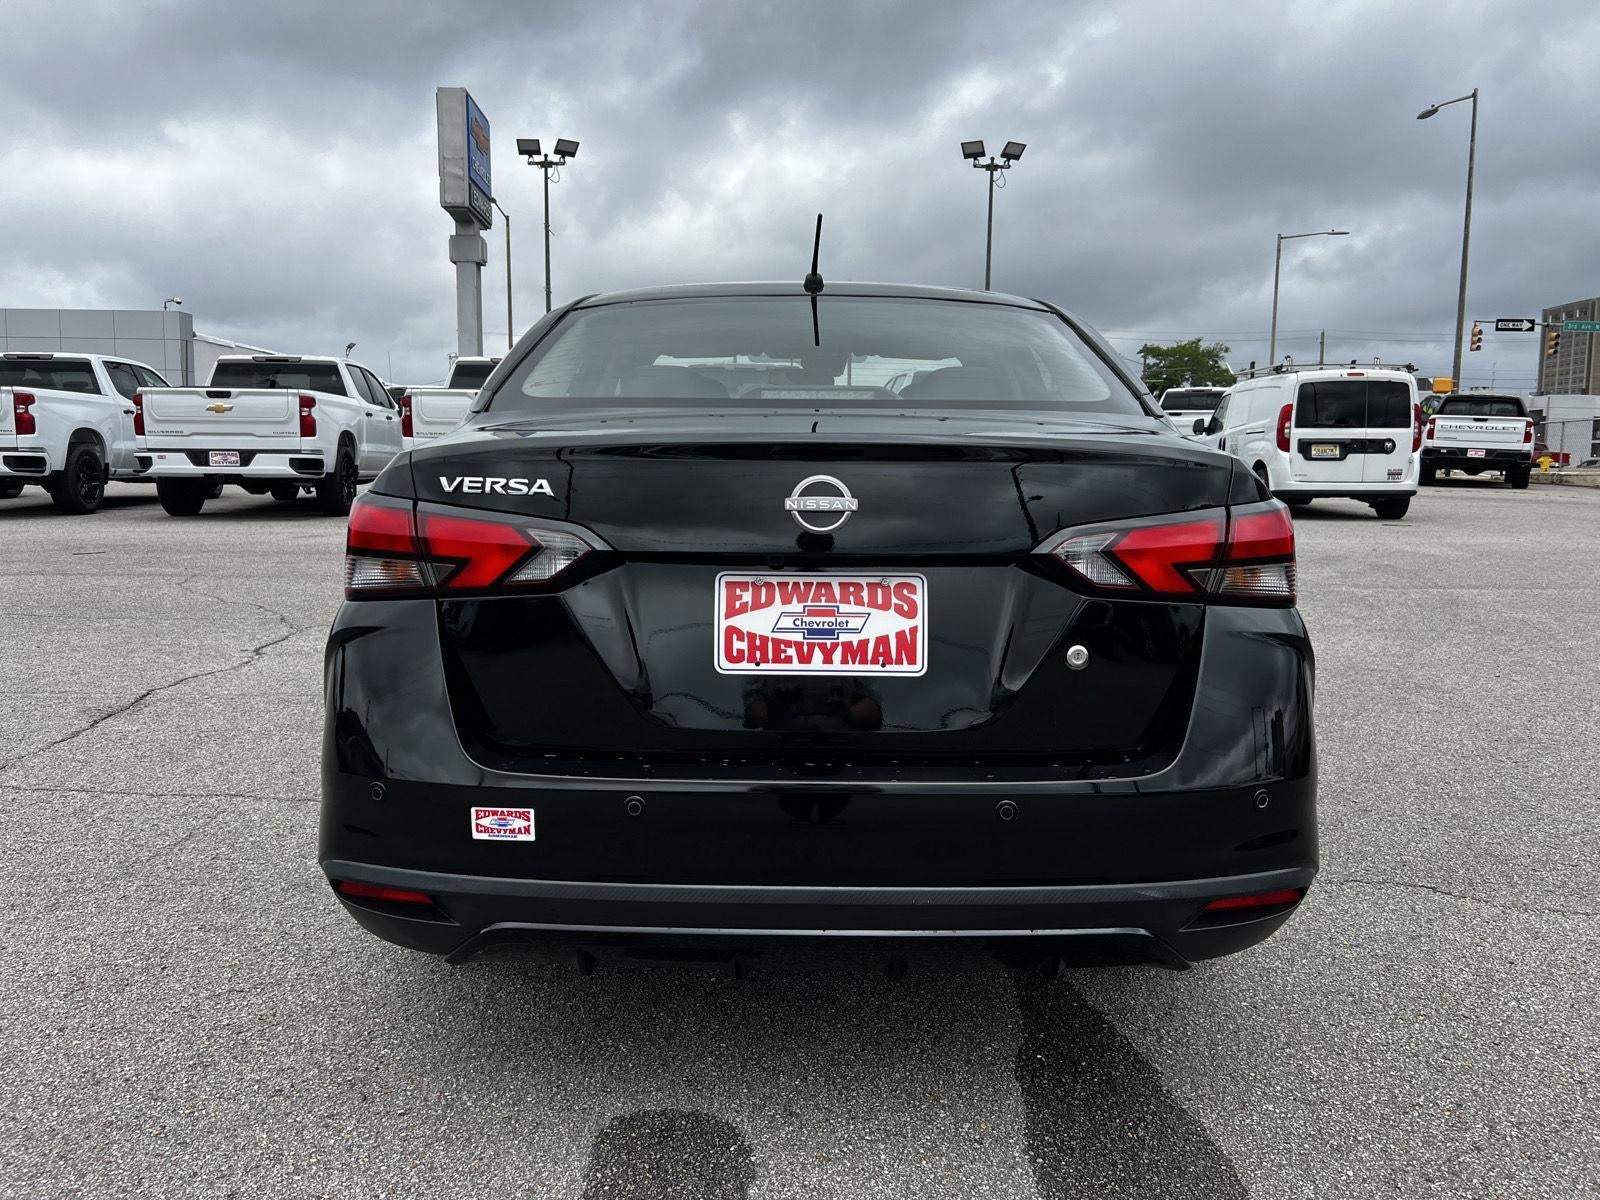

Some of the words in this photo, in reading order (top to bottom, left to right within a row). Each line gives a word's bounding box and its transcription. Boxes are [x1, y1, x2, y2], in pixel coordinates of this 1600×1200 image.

[439, 476, 555, 496] VERSA
[786, 500, 856, 509] NISSAN
[724, 580, 919, 620] EDWARDS
[792, 617, 850, 628] Chevrolet
[724, 624, 919, 665] CHEVYMAN
[475, 809, 531, 822] EDWARDS
[475, 822, 531, 835] CHEVYMAN
